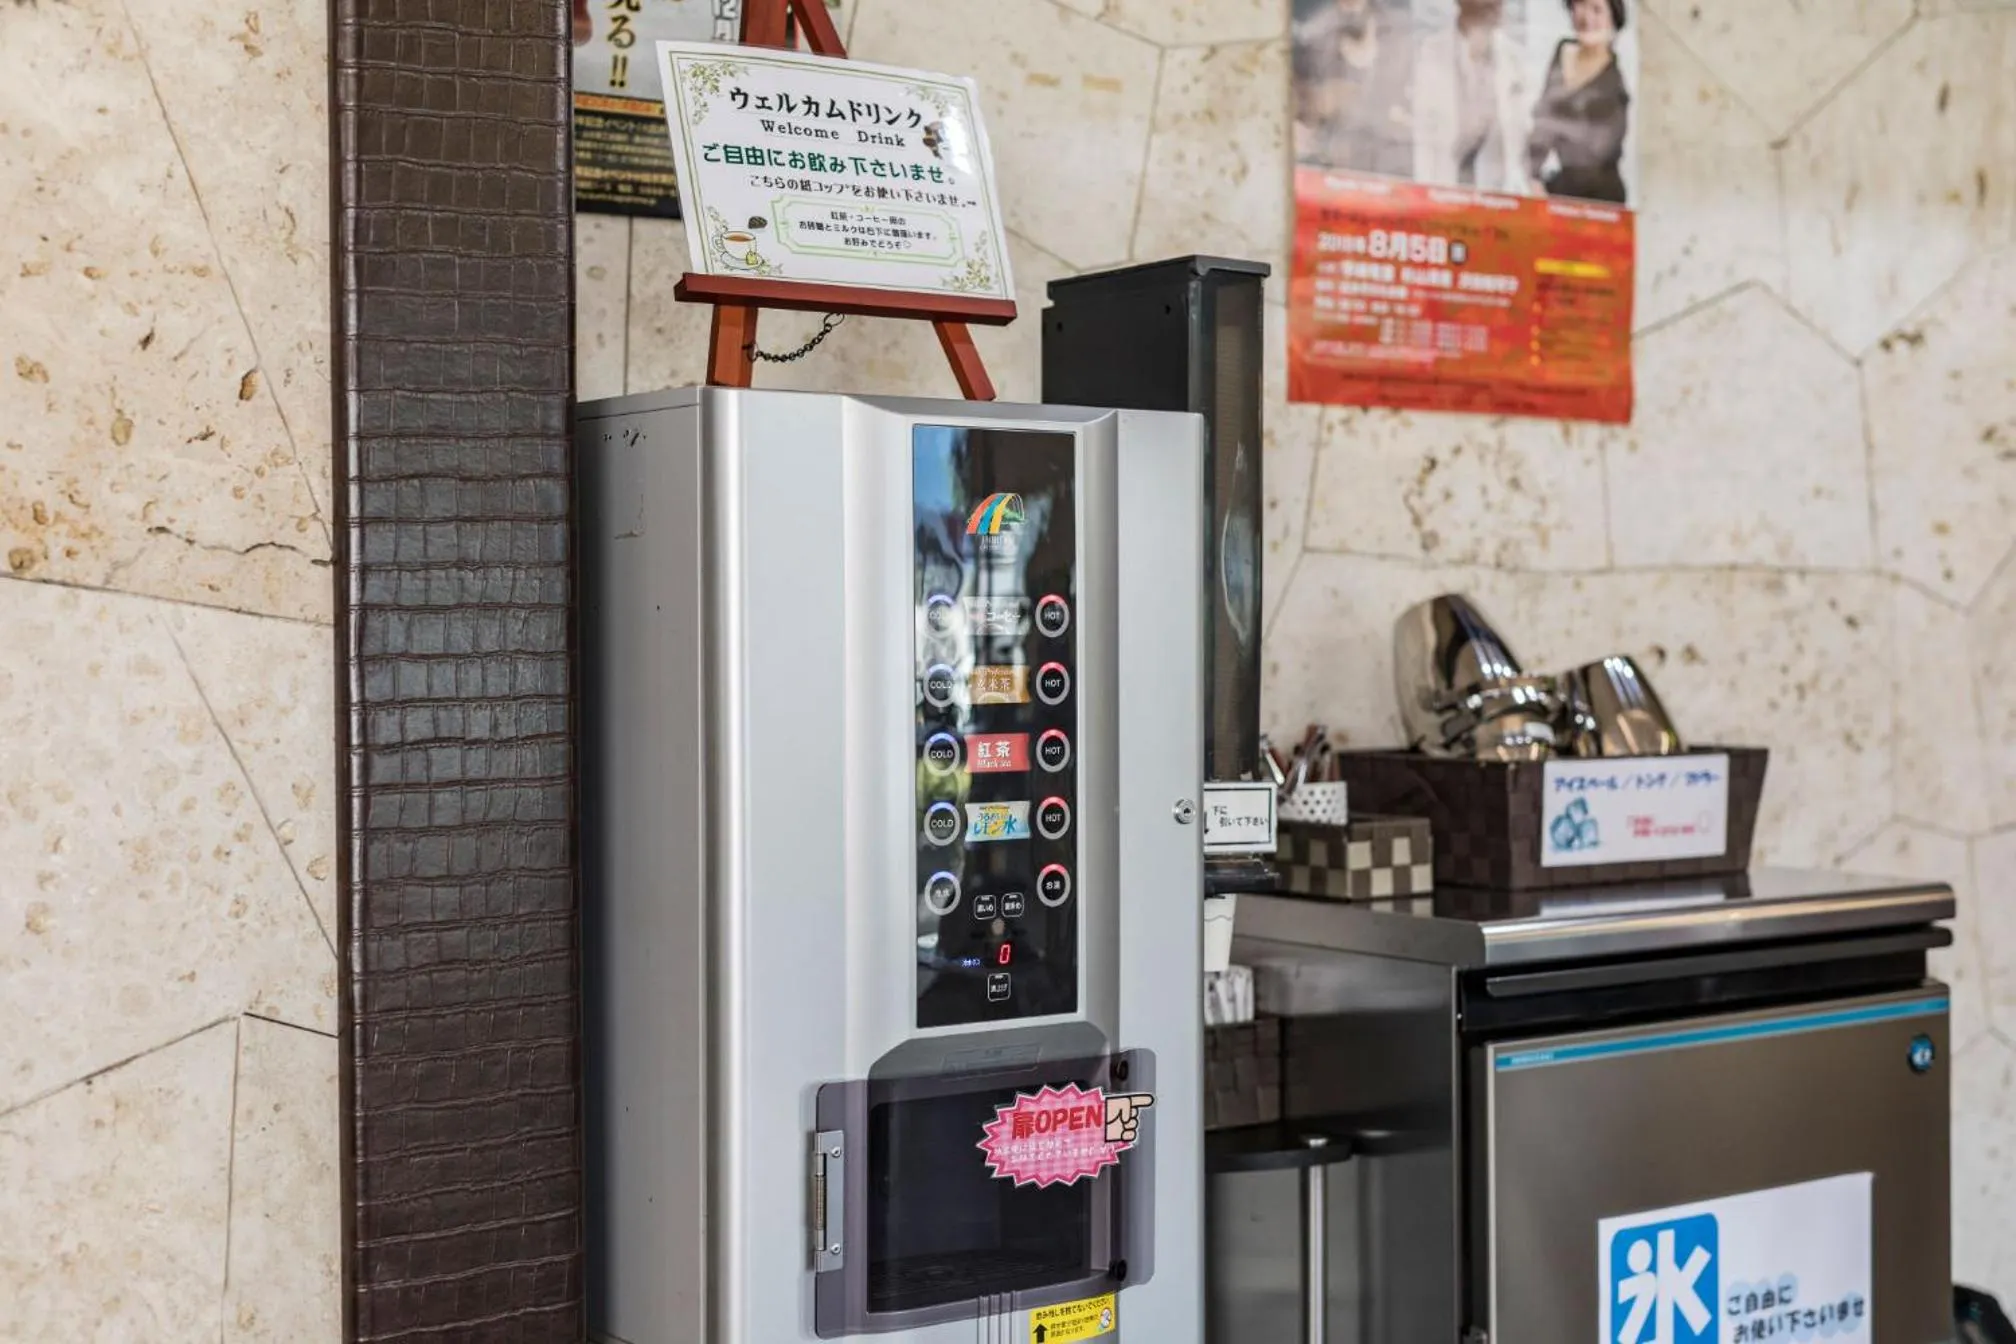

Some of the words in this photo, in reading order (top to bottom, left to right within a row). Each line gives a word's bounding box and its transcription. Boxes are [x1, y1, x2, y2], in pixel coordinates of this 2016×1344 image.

[729, 86, 922, 129] ウェルカムドリンク
[760, 119, 840, 140] Welcome
[857, 129, 906, 148] Drink
[702, 143, 956, 186] ご自由にお飲み下さいませ。
[1045, 611, 1060, 621] HOT
[930, 680, 952, 689] COLD
[1045, 679, 1061, 688] HOT
[930, 750, 954, 759] COLD
[977, 741, 1011, 758] 紅茶
[1045, 747, 1061, 755] HOT
[930, 819, 954, 828] COLD
[1045, 813, 1061, 822] HOT
[999, 943, 1011, 965] 0
[1012, 1104, 1101, 1140] 扉OPEN
[1727, 1284, 1792, 1316] ご自由に
[1733, 1297, 1864, 1344] お使い下さいませ
